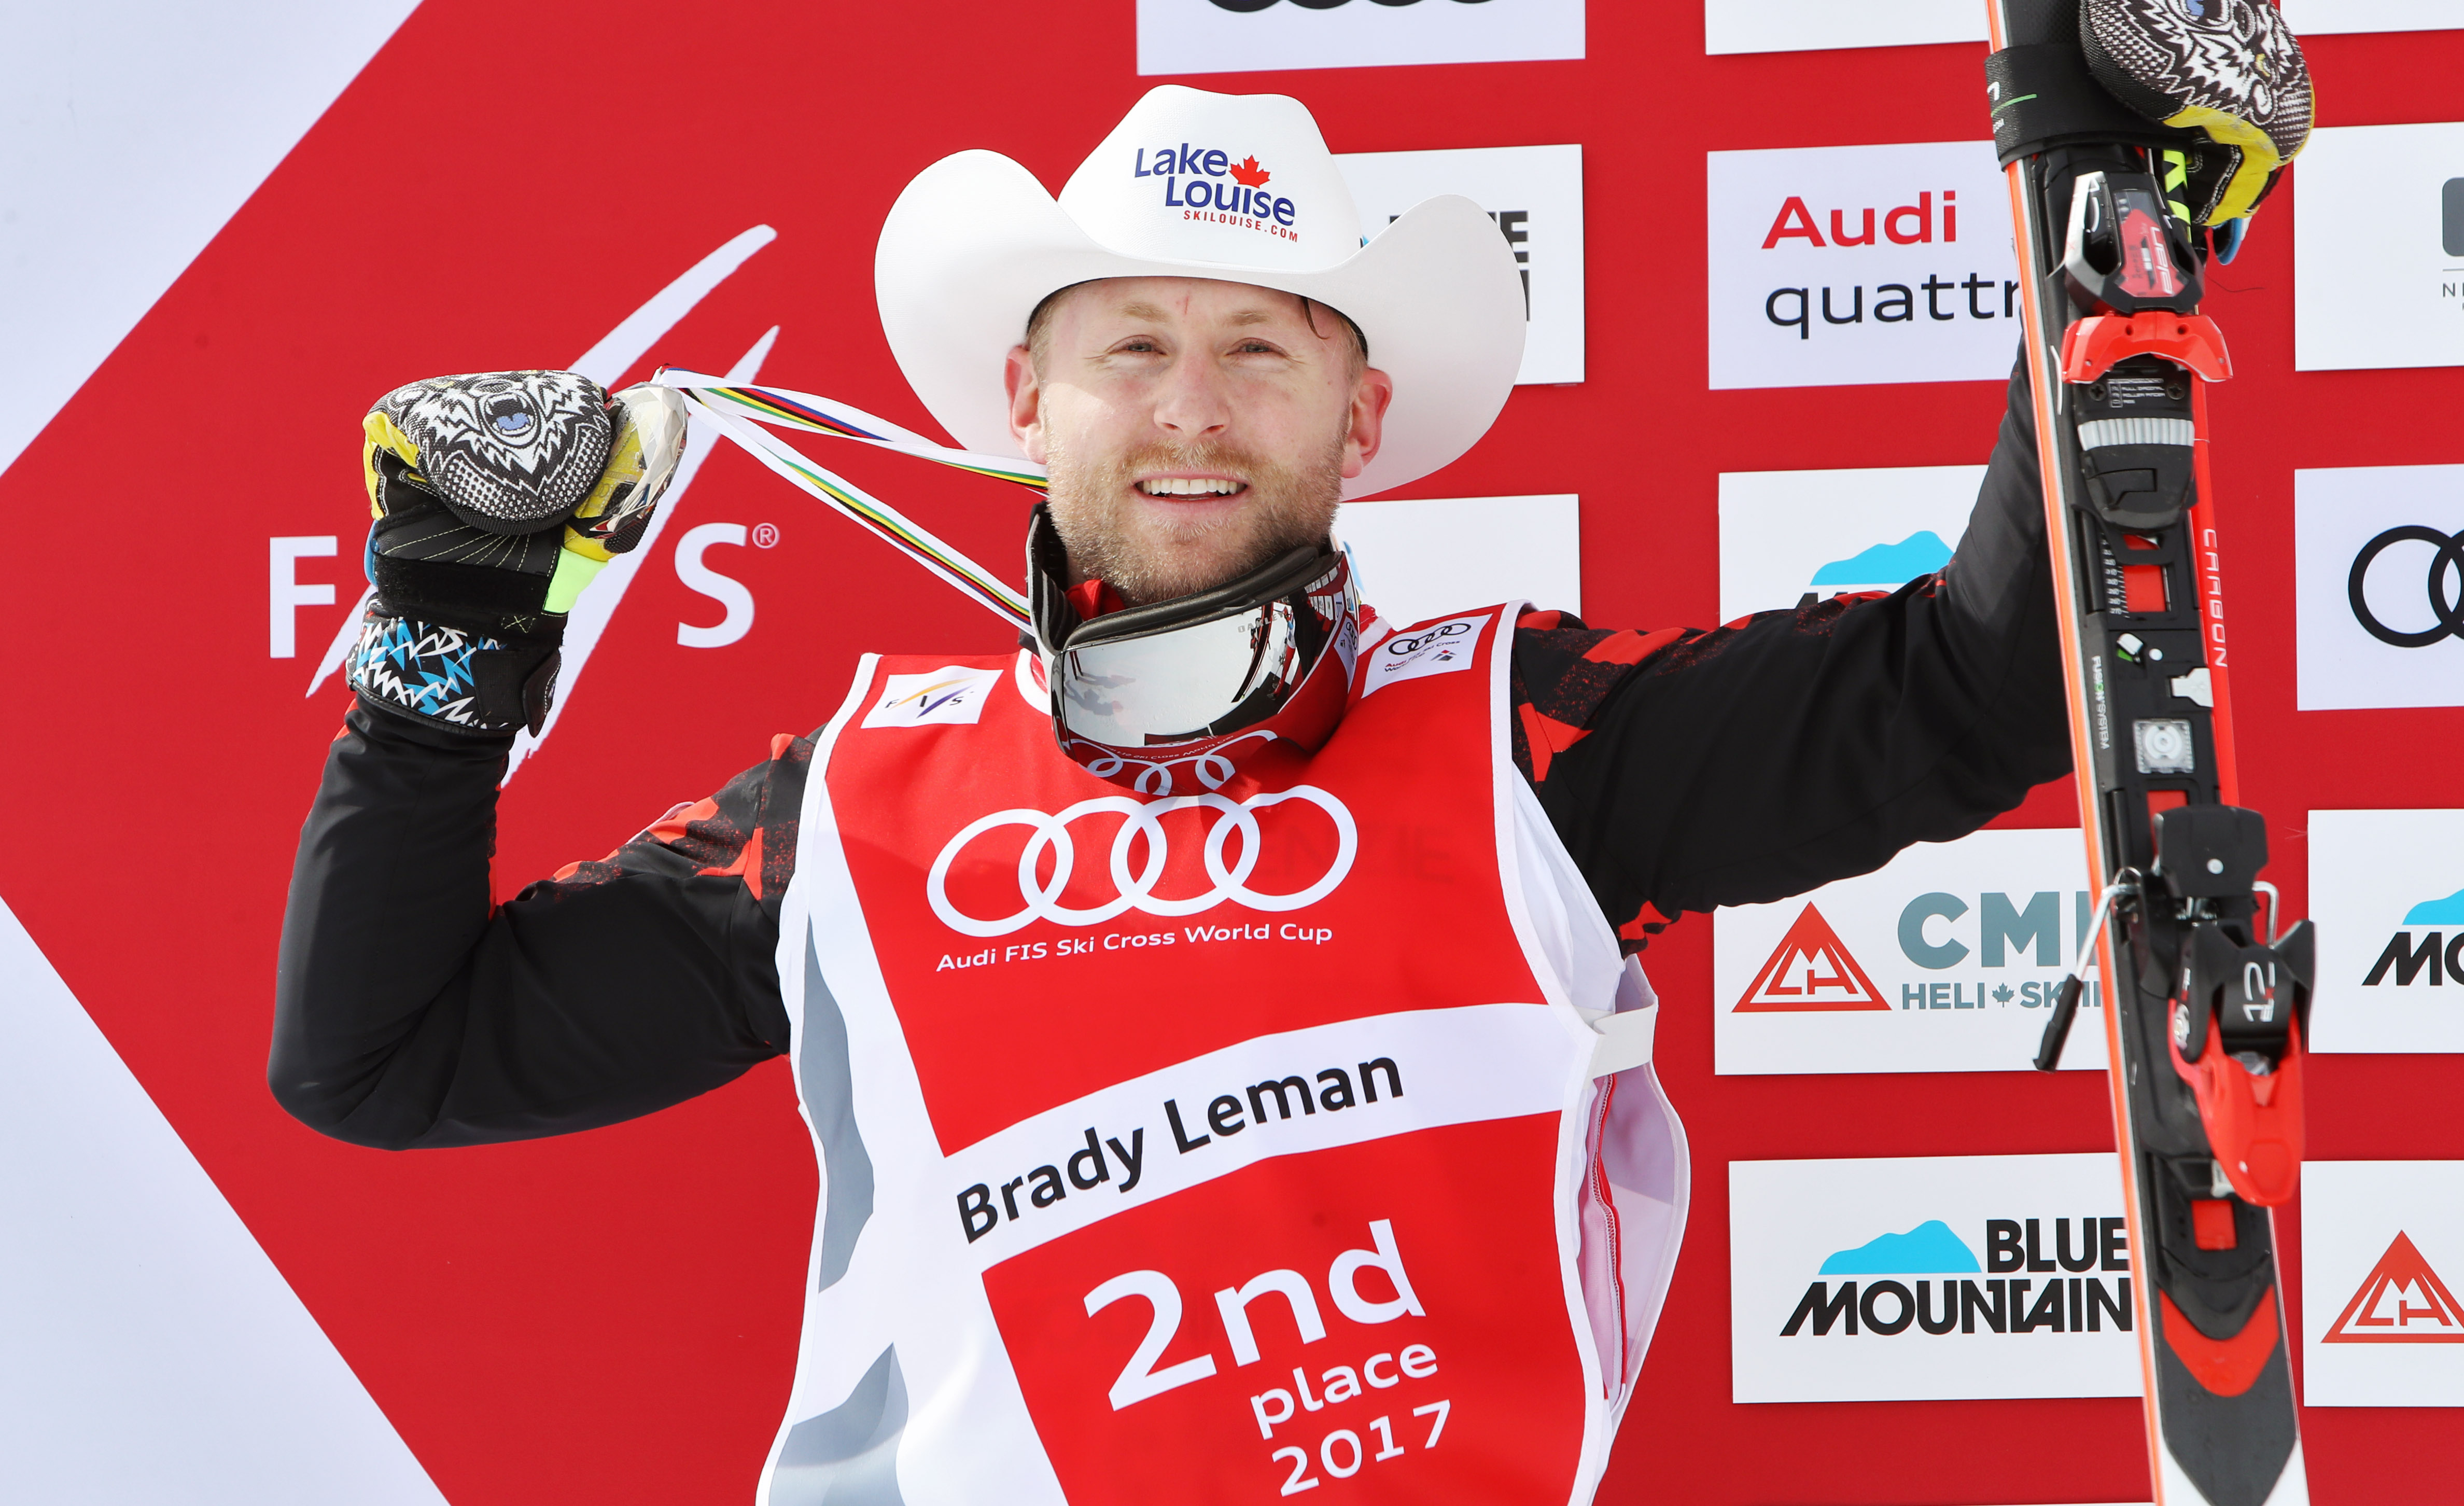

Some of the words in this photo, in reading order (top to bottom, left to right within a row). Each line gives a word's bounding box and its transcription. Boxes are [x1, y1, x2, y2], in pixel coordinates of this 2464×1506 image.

[1135, 143, 1228, 177] Lake
[1166, 176, 1295, 226] Louise
[1183, 210, 1298, 243] SKILOUISE.COM
[1761, 190, 1956, 249] Audi
[1237, 610, 1285, 633] OAKLEY
[2203, 528, 2228, 667] CARBON
[936, 947, 996, 971] Audi
[1005, 942, 1047, 963] FIS
[1056, 935, 1095, 956] Ski
[1103, 929, 1175, 951] Cross
[1184, 923, 1270, 943] World
[1279, 923, 1333, 945] Cup
[1902, 982, 1985, 1010] HELI
[2243, 961, 2276, 1023] 12
[956, 1126, 1144, 1245] Brady
[1164, 1056, 1404, 1154] Leman
[1986, 1217, 2130, 1273] BLUE
[1083, 1218, 1426, 1412] 2nd
[1779, 1278, 2133, 1336] MOUNTAIN
[1250, 1344, 1438, 1440] place
[1271, 1399, 1451, 1497] 2017
